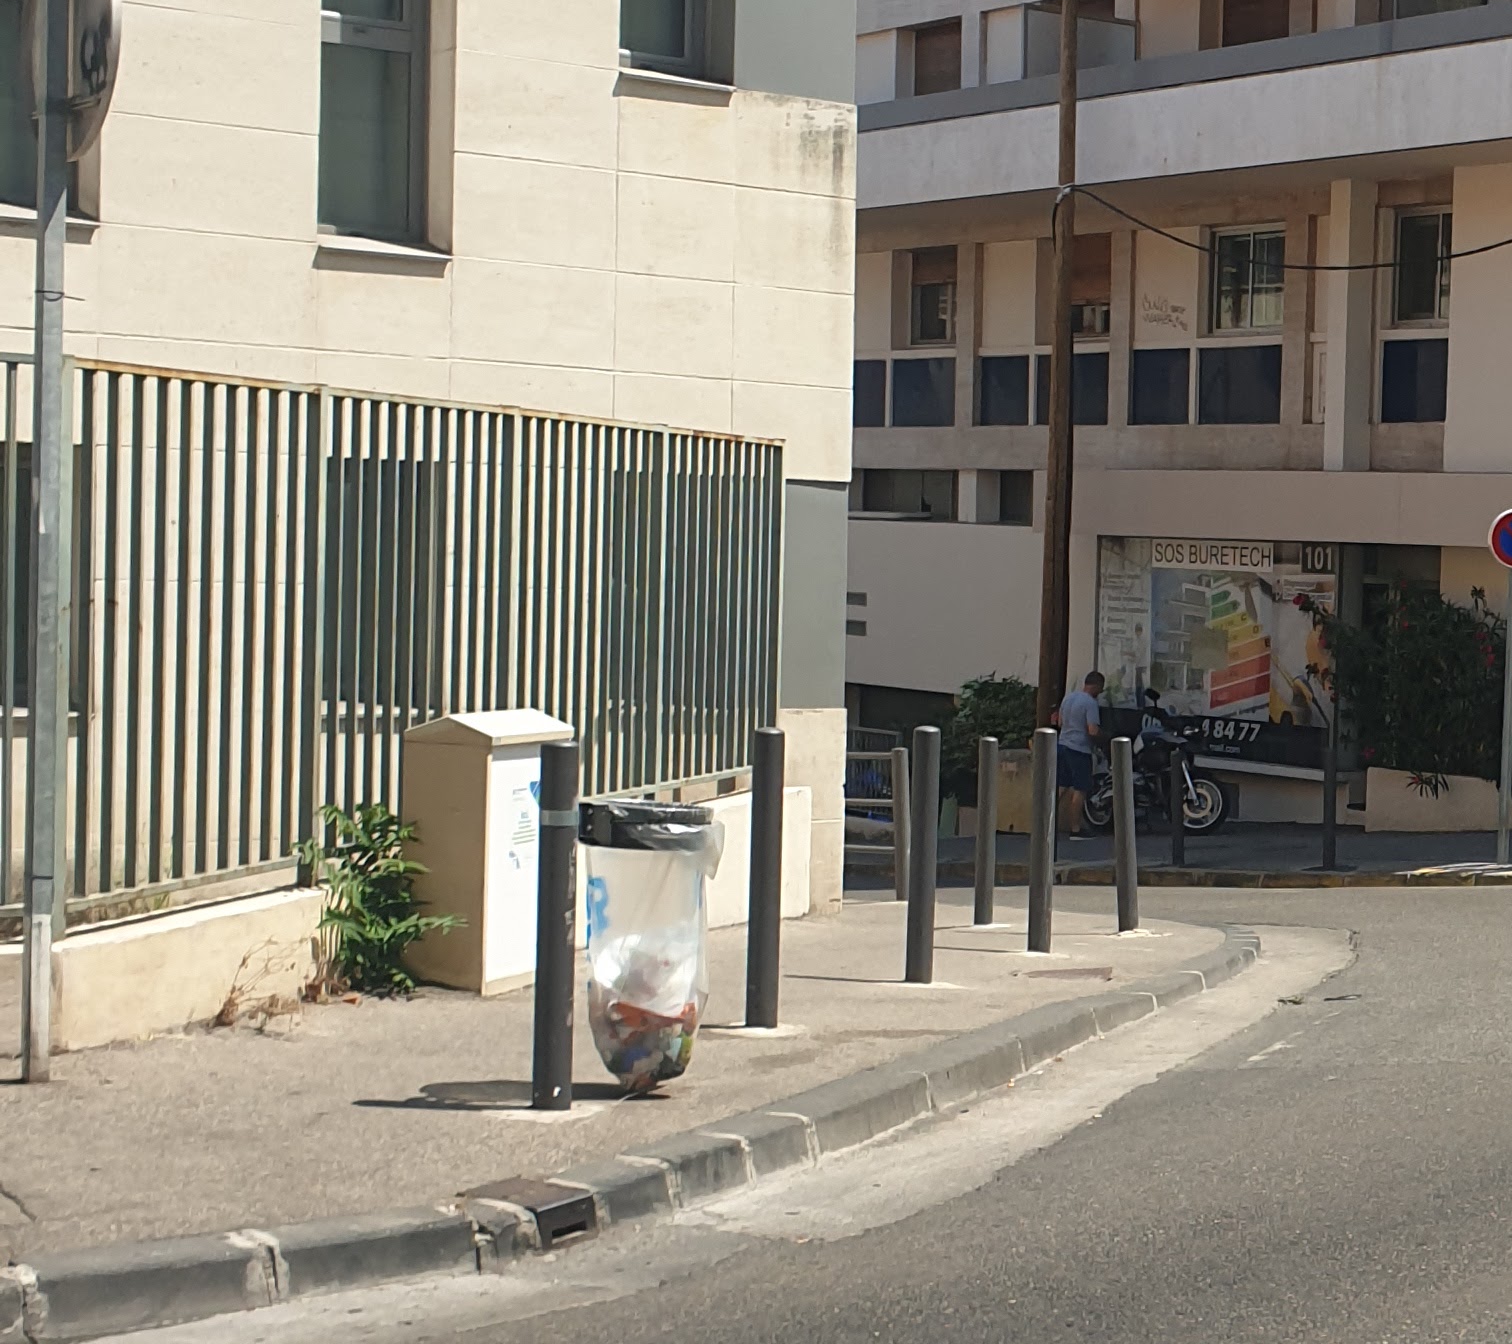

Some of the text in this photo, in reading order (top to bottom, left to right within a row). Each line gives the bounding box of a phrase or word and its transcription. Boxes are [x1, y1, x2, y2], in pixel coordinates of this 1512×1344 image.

[1154, 543, 1272, 568] SOS BURETECH
[1305, 546, 1332, 570] 101
